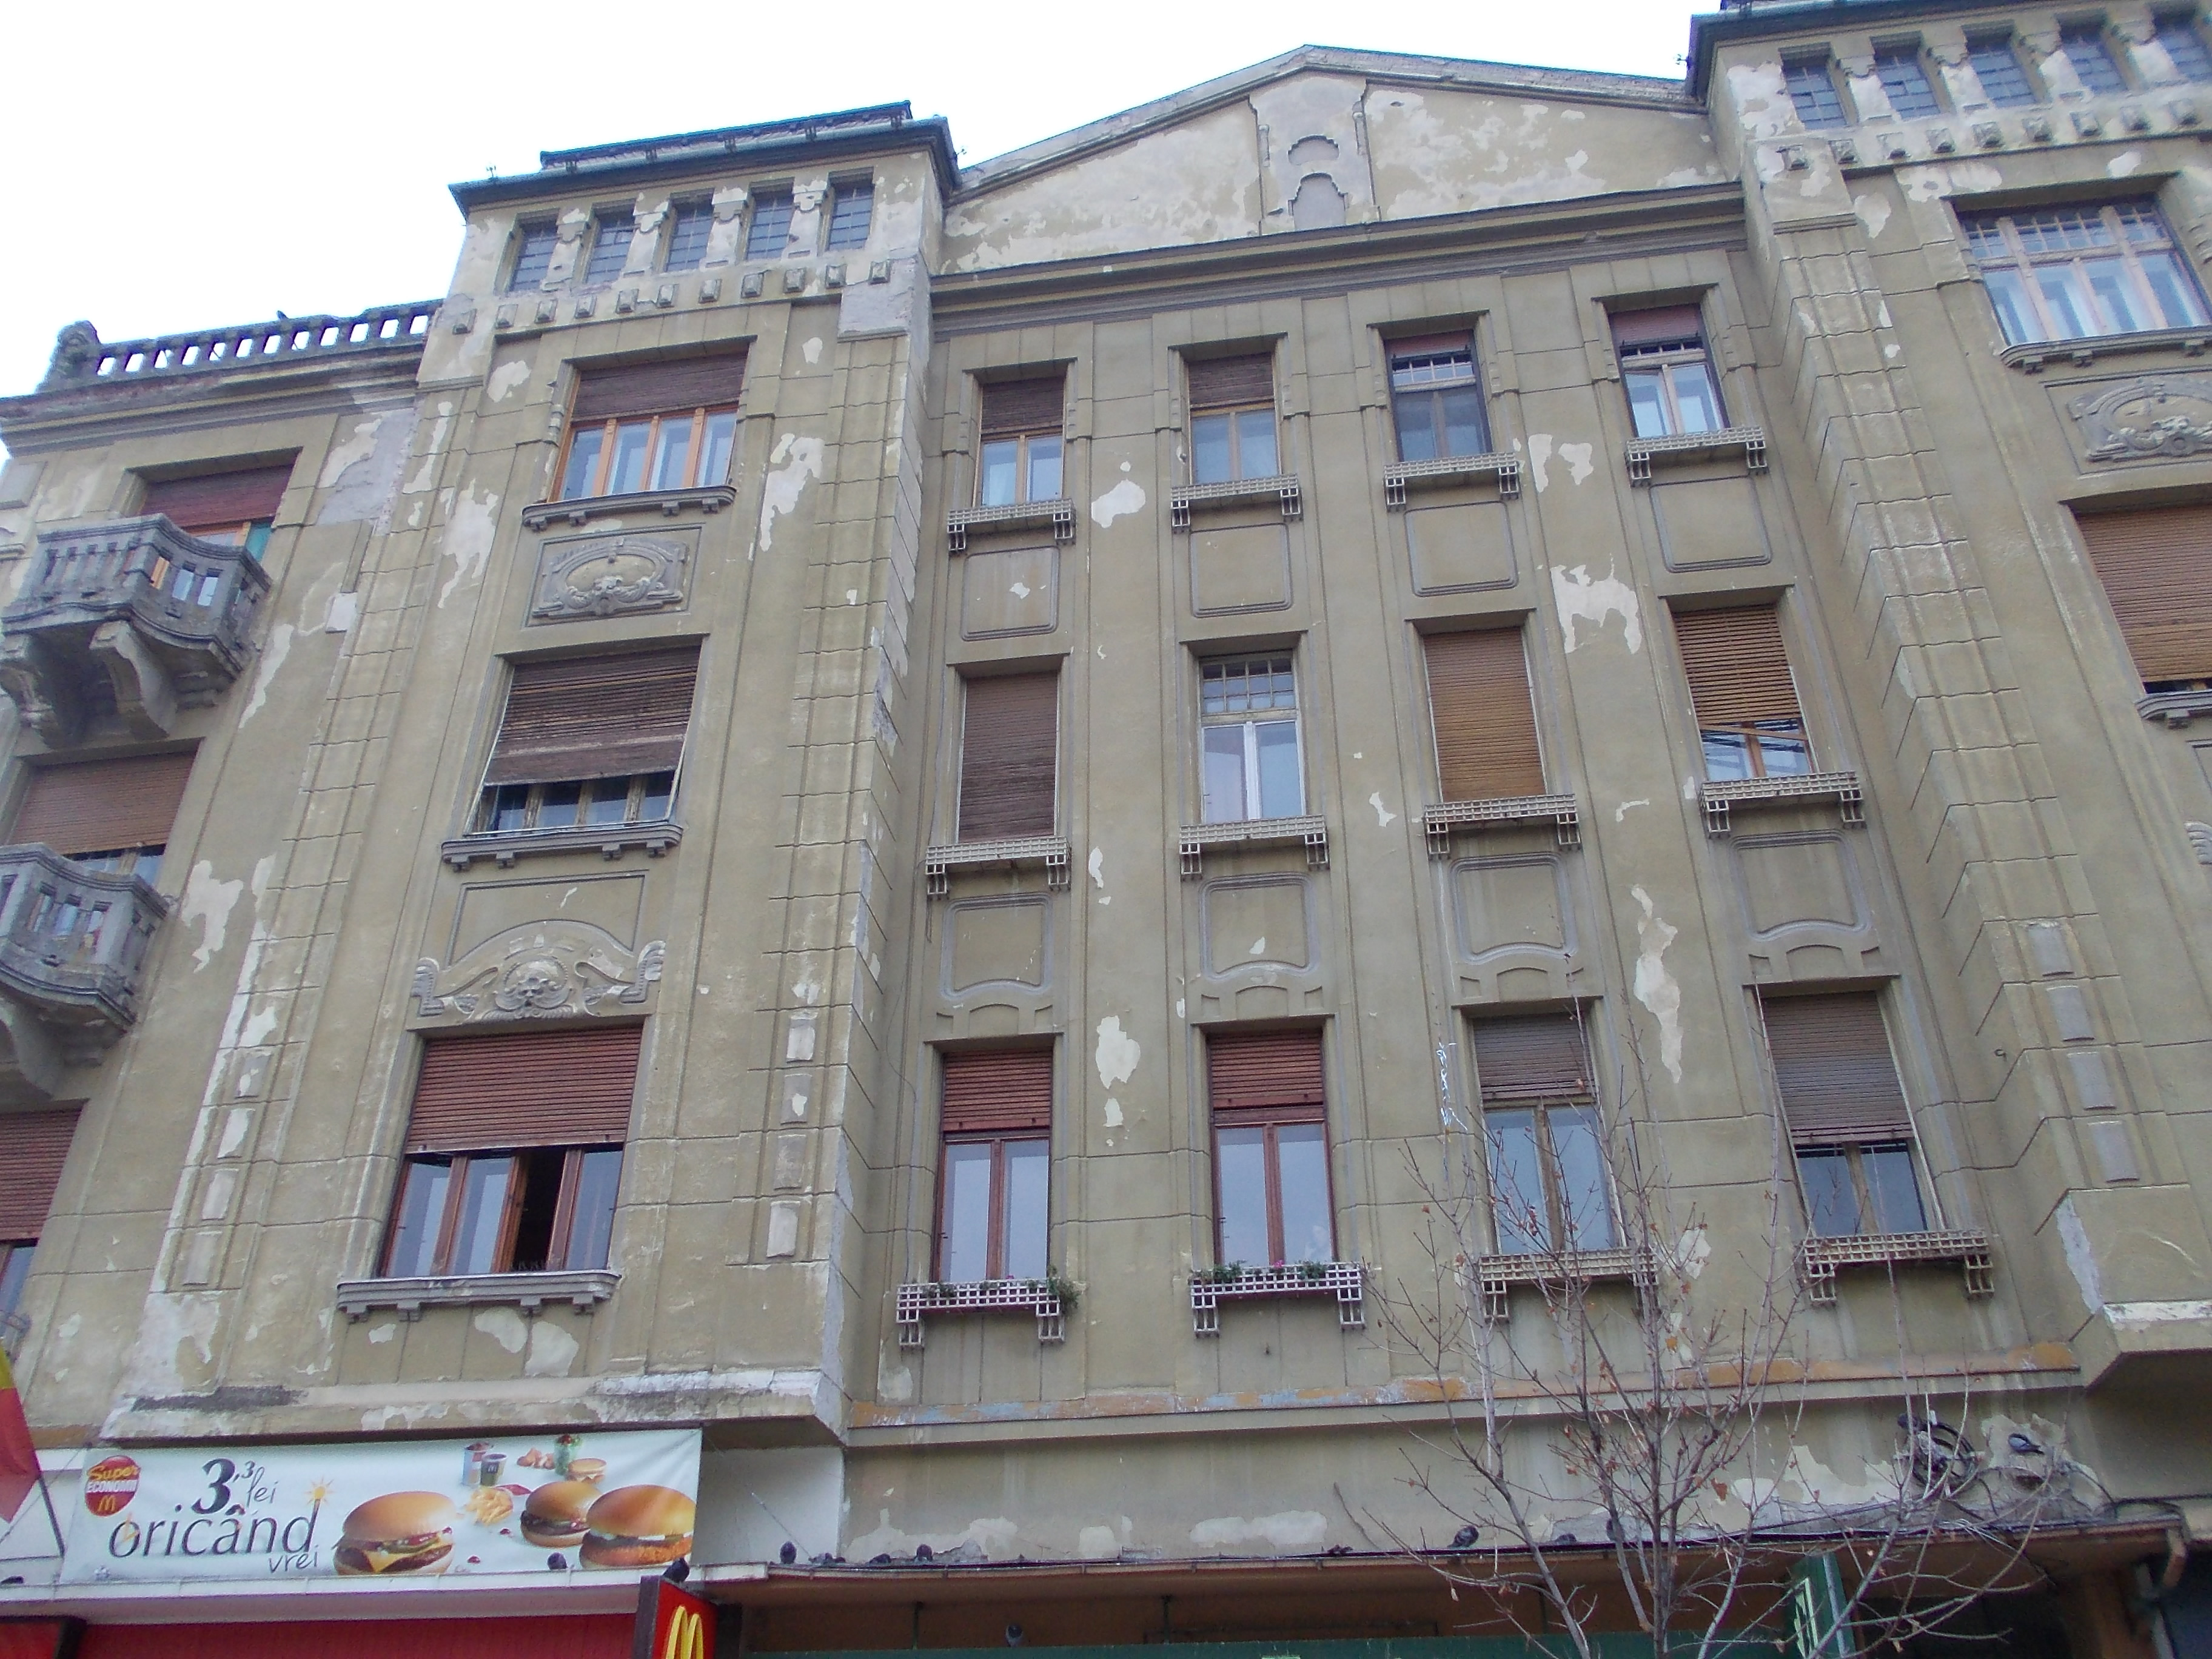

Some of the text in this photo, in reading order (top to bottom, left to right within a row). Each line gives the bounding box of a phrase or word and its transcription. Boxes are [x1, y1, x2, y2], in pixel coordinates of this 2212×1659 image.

[87, 1464, 139, 1481] Super
[246, 1466, 279, 1507] lei
[109, 1499, 321, 1558] oricând
[268, 1545, 319, 1574] vrei
